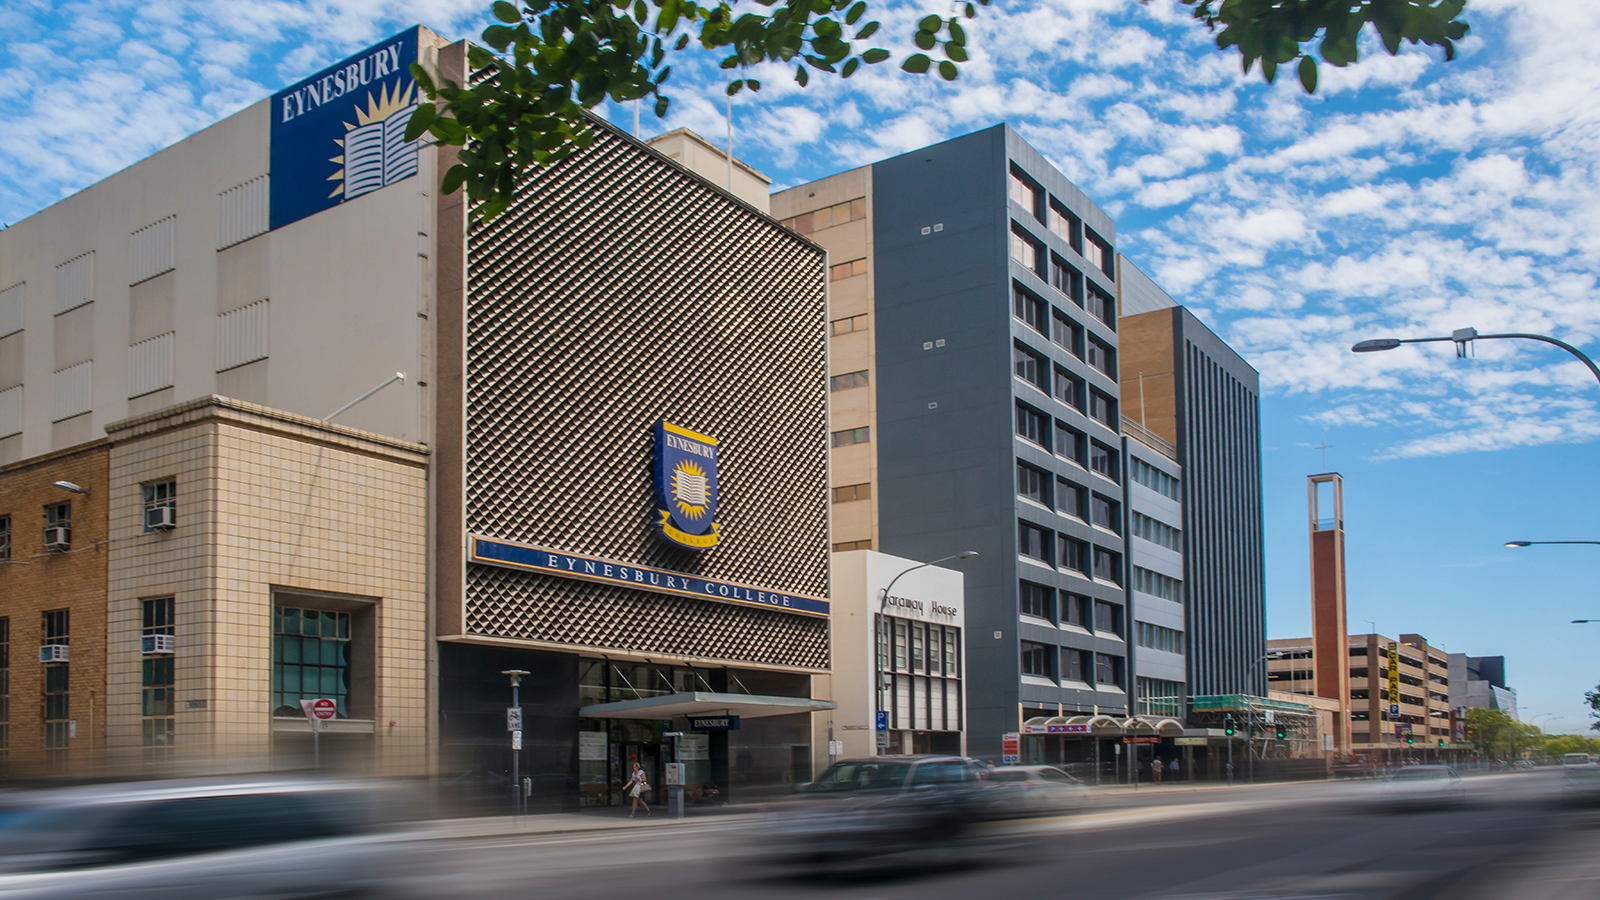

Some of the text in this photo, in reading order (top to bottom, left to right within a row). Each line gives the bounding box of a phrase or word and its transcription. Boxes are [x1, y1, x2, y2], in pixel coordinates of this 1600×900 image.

[281, 41, 403, 123] EYNESBURY
[666, 433, 714, 459] EYNESBURY
[668, 529, 713, 544] COLLEGE
[548, 554, 791, 607] EYNESBURY COLLEGE
[931, 600, 957, 616] House
[1389, 653, 1397, 672] CAR
[1389, 677, 1398, 703] PARK
[694, 719, 729, 728] EYNESBURY
[877, 713, 885, 721] P
